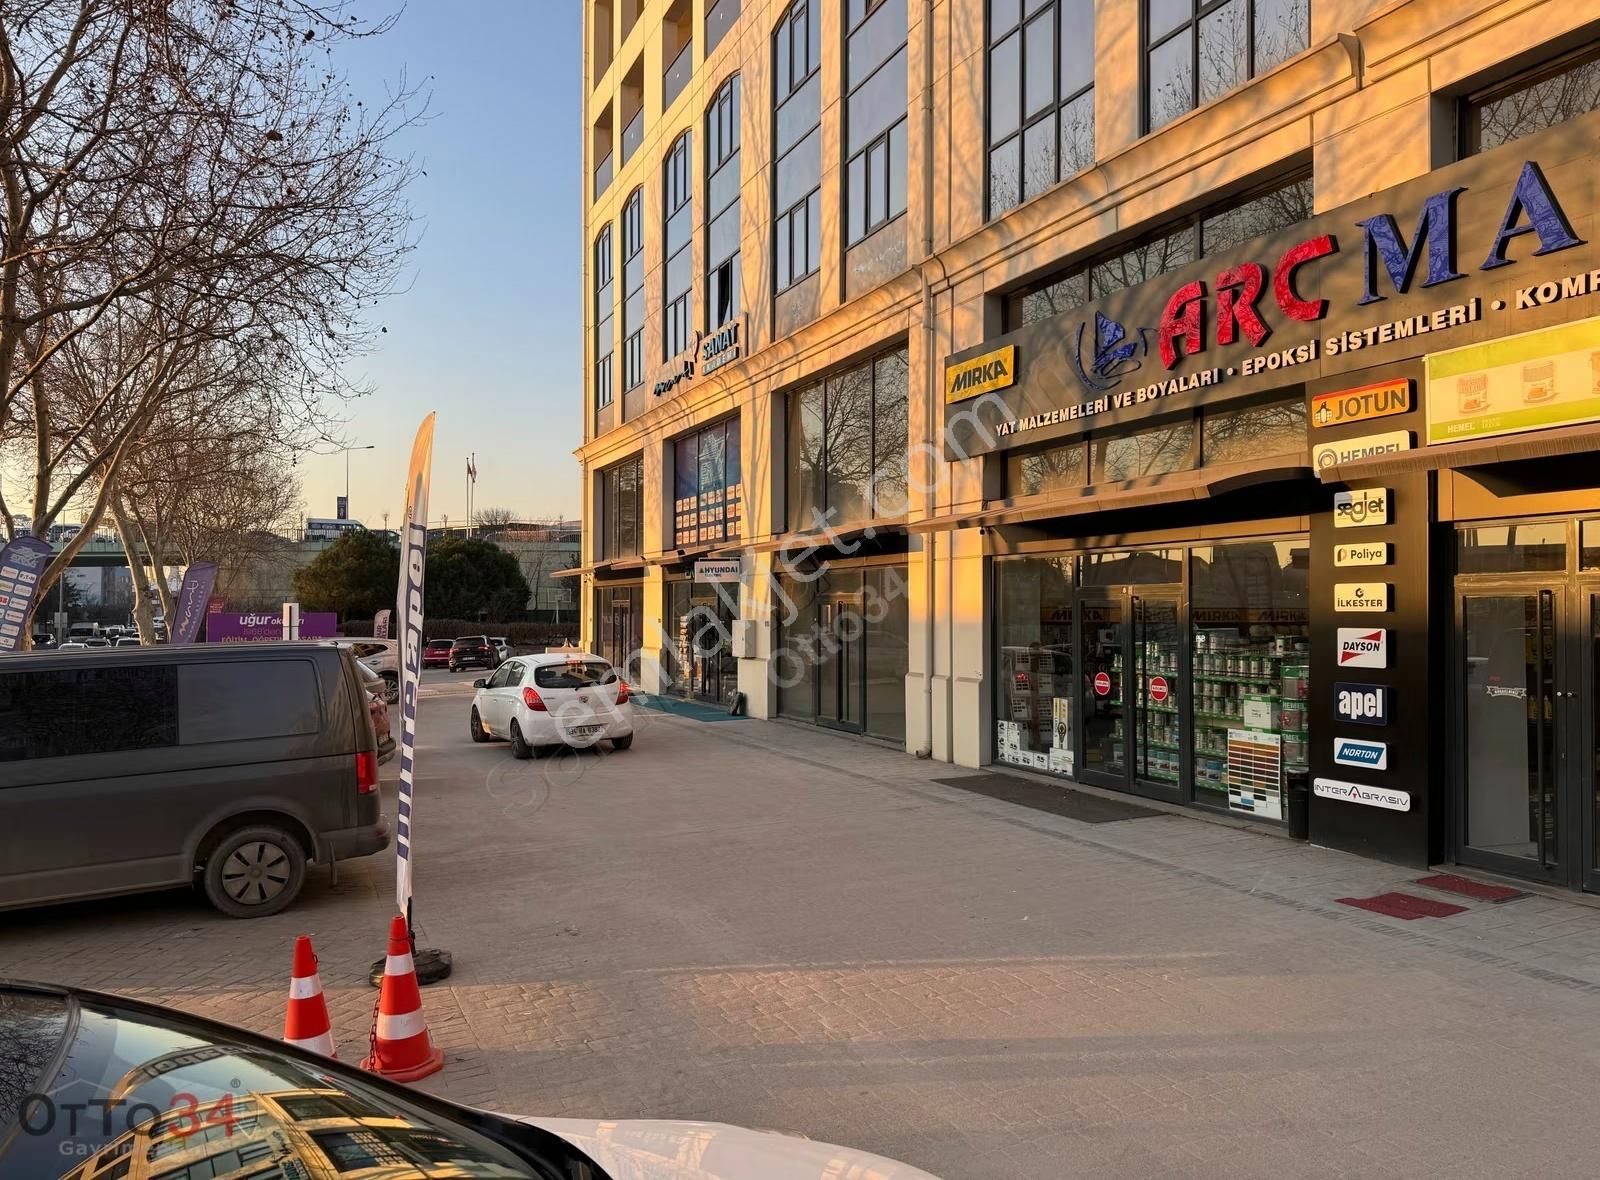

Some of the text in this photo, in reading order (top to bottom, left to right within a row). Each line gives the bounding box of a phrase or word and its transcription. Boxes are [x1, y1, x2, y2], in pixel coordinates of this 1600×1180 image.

[1157, 234, 1337, 368] ARC
[950, 359, 1009, 393] MIRKA
[996, 422, 1016, 437] YAT
[1019, 396, 1109, 432] MALZEMELERİ
[1113, 391, 1131, 409] VE
[1136, 367, 1219, 403] BOYALARI
[1241, 339, 1316, 377] EPOKSİ
[1325, 298, 1478, 356] SİSTEMLERİ
[1335, 387, 1406, 421] JOTUN
[1350, 549, 1383, 560] Poliya
[1337, 597, 1383, 608] İLKESTER
[240, 613, 271, 627] uğur
[1342, 641, 1381, 652] DAYSON
[1338, 688, 1383, 720] apel
[1342, 747, 1379, 760] NORTON
